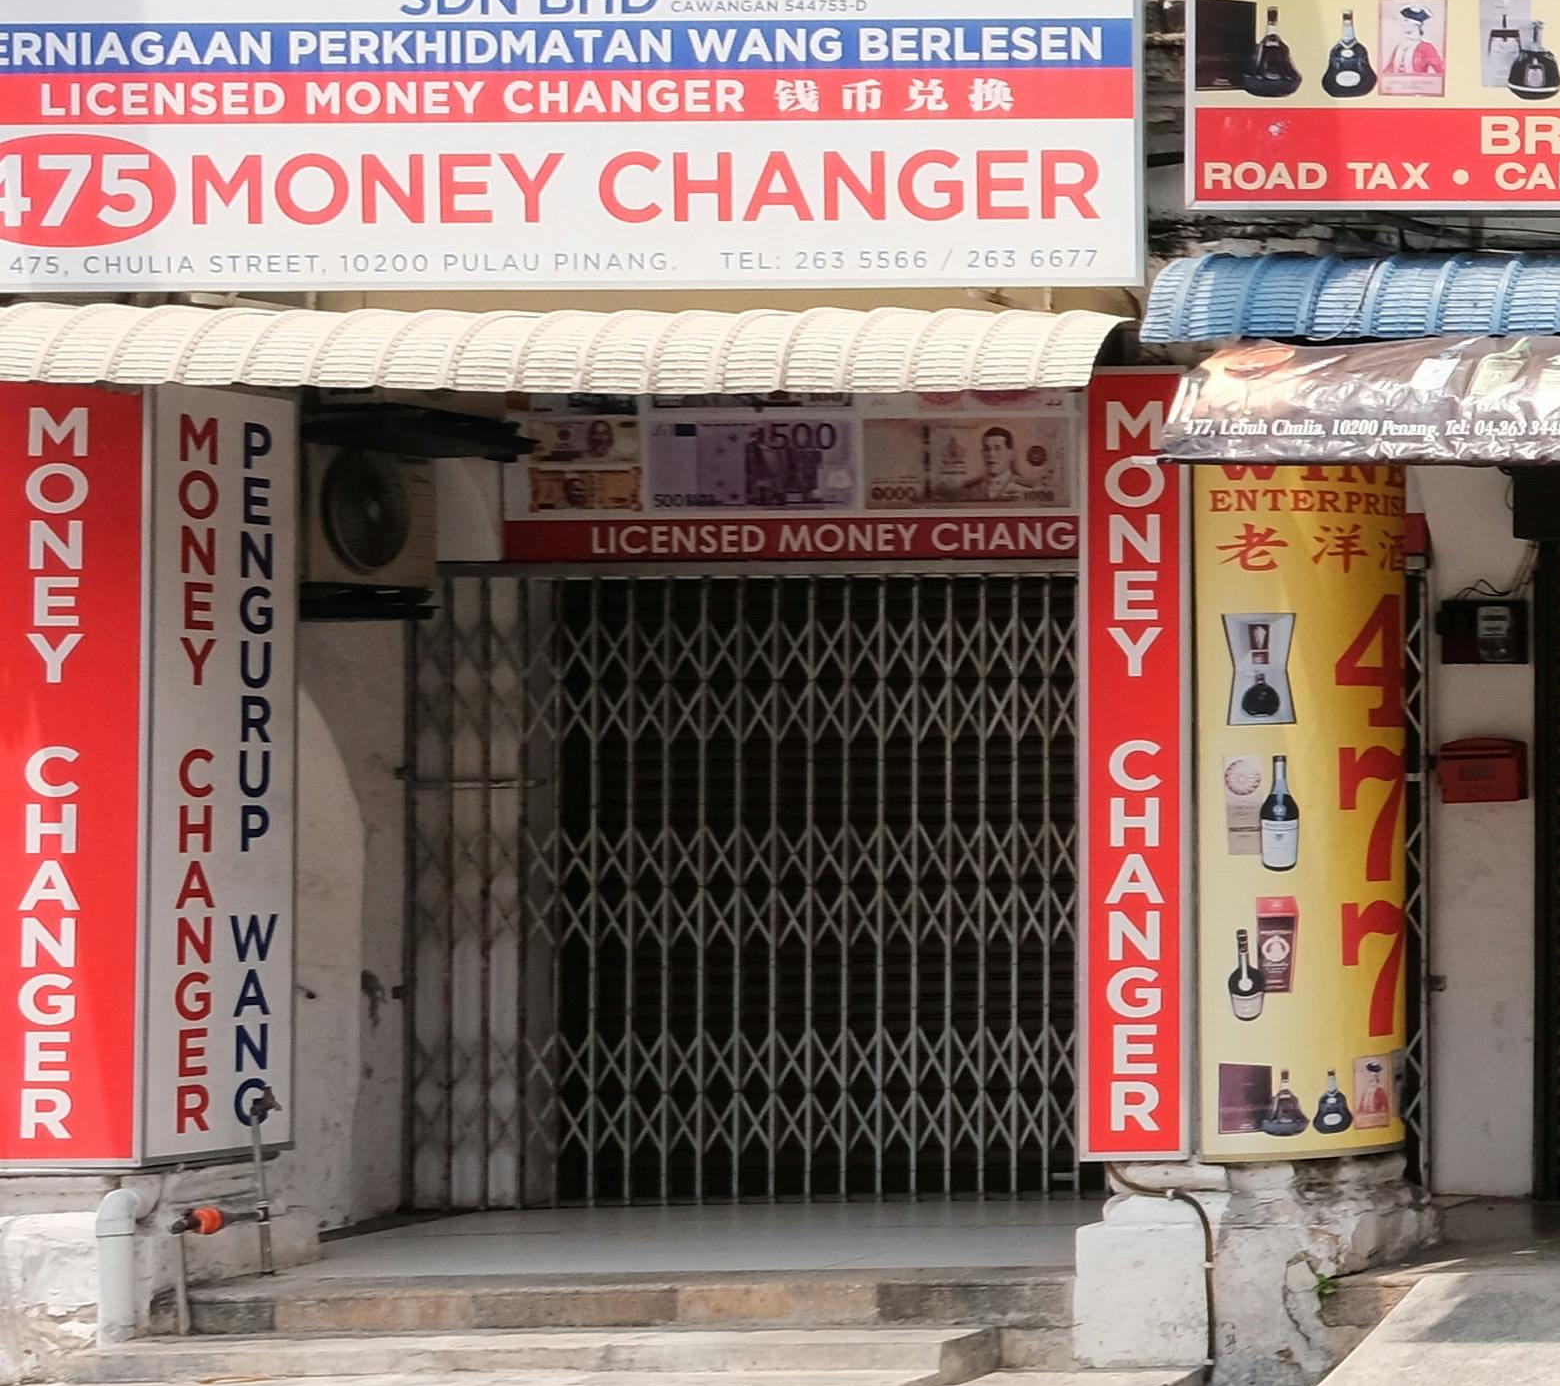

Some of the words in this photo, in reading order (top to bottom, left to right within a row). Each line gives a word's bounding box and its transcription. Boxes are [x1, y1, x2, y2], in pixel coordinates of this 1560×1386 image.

[290, 29, 671, 64] PERKHIDMATAN
[688, 28, 842, 62] WANG
[860, 27, 1101, 61] BERLESEN
[671, 0, 778, 12] CAWANGAN
[785, 0, 867, 12] 544753-D
[42, 82, 285, 115] LICENSED
[307, 82, 484, 114] MONEY
[504, 80, 744, 113] CHANGER
[775, 79, 1013, 112] 钱币兑换
[192, 153, 564, 225] MONEY
[599, 150, 1099, 223] CHANGER
[1205, 162, 1327, 190] ROAD
[1347, 163, 1429, 189] TAX
[10, 256, 68, 276] 475,
[83, 256, 193, 274] CHULIA
[210, 255, 325, 273] STREET,
[341, 254, 427, 272] 10200
[444, 254, 538, 271] PULAU
[555, 253, 676, 271] PINANG.
[720, 252, 780, 269] TEL:
[796, 252, 844, 269] 263
[860, 251, 927, 268] 5566
[940, 248, 953, 271] /
[968, 250, 1015, 268] 263
[1031, 250, 1097, 267] 6677
[1332, 419, 1378, 436] 10200
[26, 408, 88, 683] MONEY
[179, 414, 218, 685] MONEY
[593, 525, 765, 553] LICENSED
[779, 524, 918, 552] MONEY
[932, 522, 1076, 551] CHANG
[1104, 401, 1164, 677] MONEY
[240, 422, 273, 851] PENGURUP
[18, 747, 79, 1138] CHANGER
[175, 749, 215, 1133] CHANGER
[1105, 740, 1164, 1131] CHANGER
[230, 914, 278, 1127] WANG
